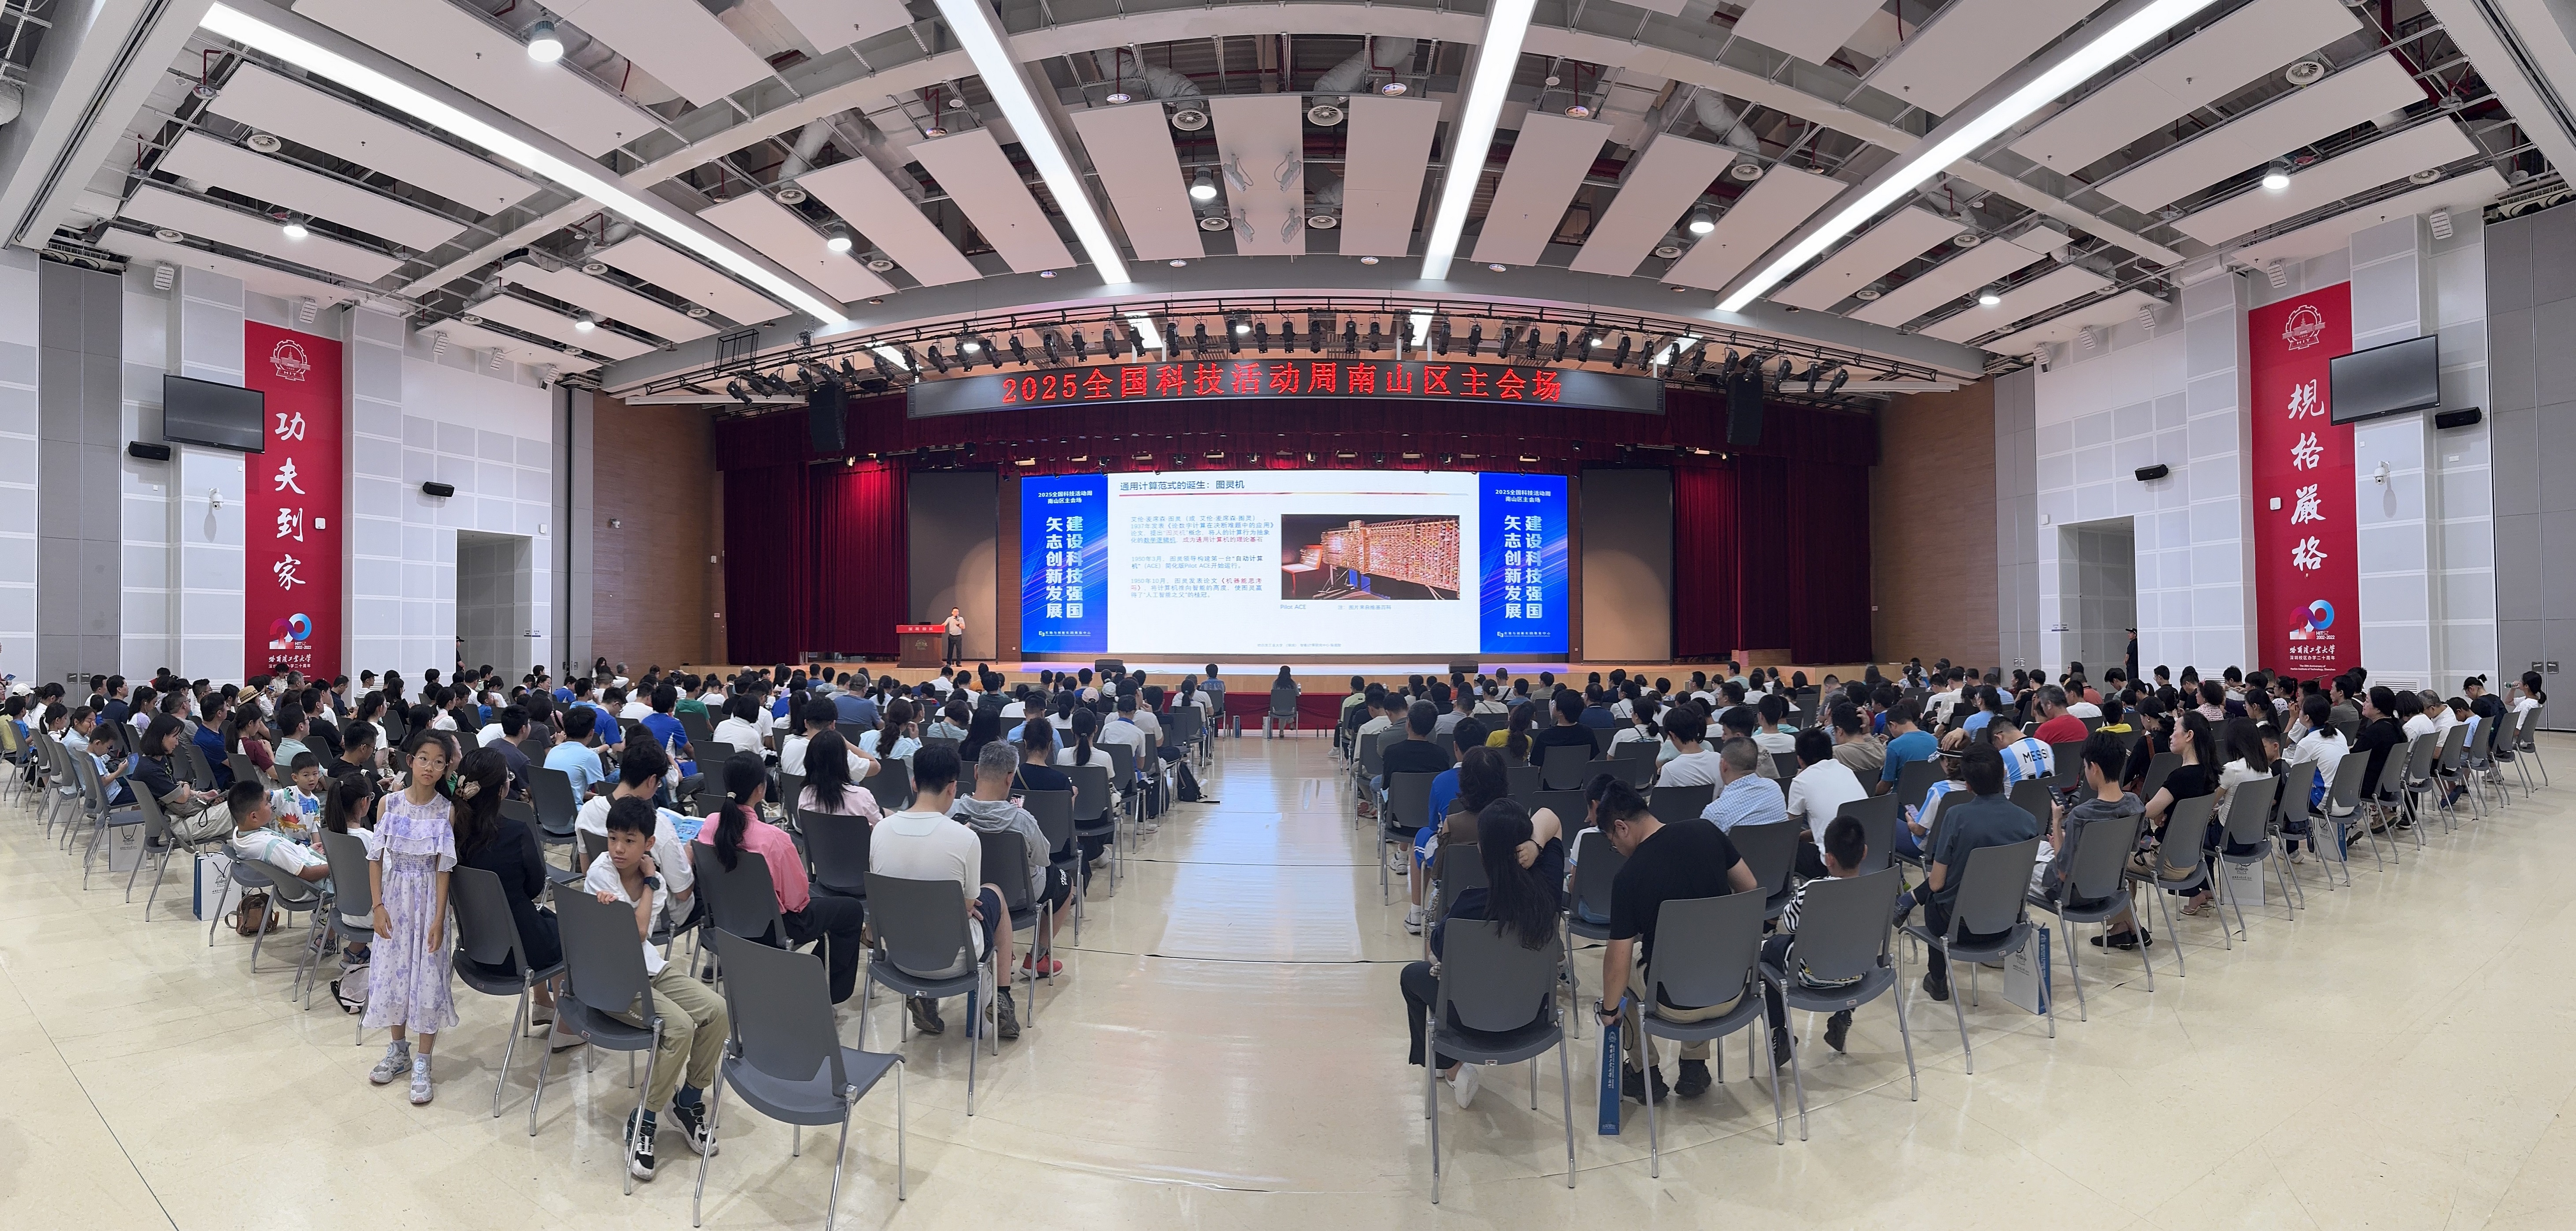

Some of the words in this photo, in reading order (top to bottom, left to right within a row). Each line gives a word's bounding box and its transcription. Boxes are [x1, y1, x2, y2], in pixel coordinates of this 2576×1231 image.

[1002, 362, 1561, 403] 2025全国科技活动周南山区主会场
[273, 412, 306, 591] 功夫到家
[1121, 480, 1245, 490] 通用计算范式的诞生：图灵机
[1046, 517, 1063, 618] 矢志创新发展
[1066, 516, 1084, 618] 建设科技强国
[1504, 515, 1522, 619] 矢志创新发展
[1525, 515, 1543, 619] 建设科技强国
[2023, 748, 2049, 763] MESSI
